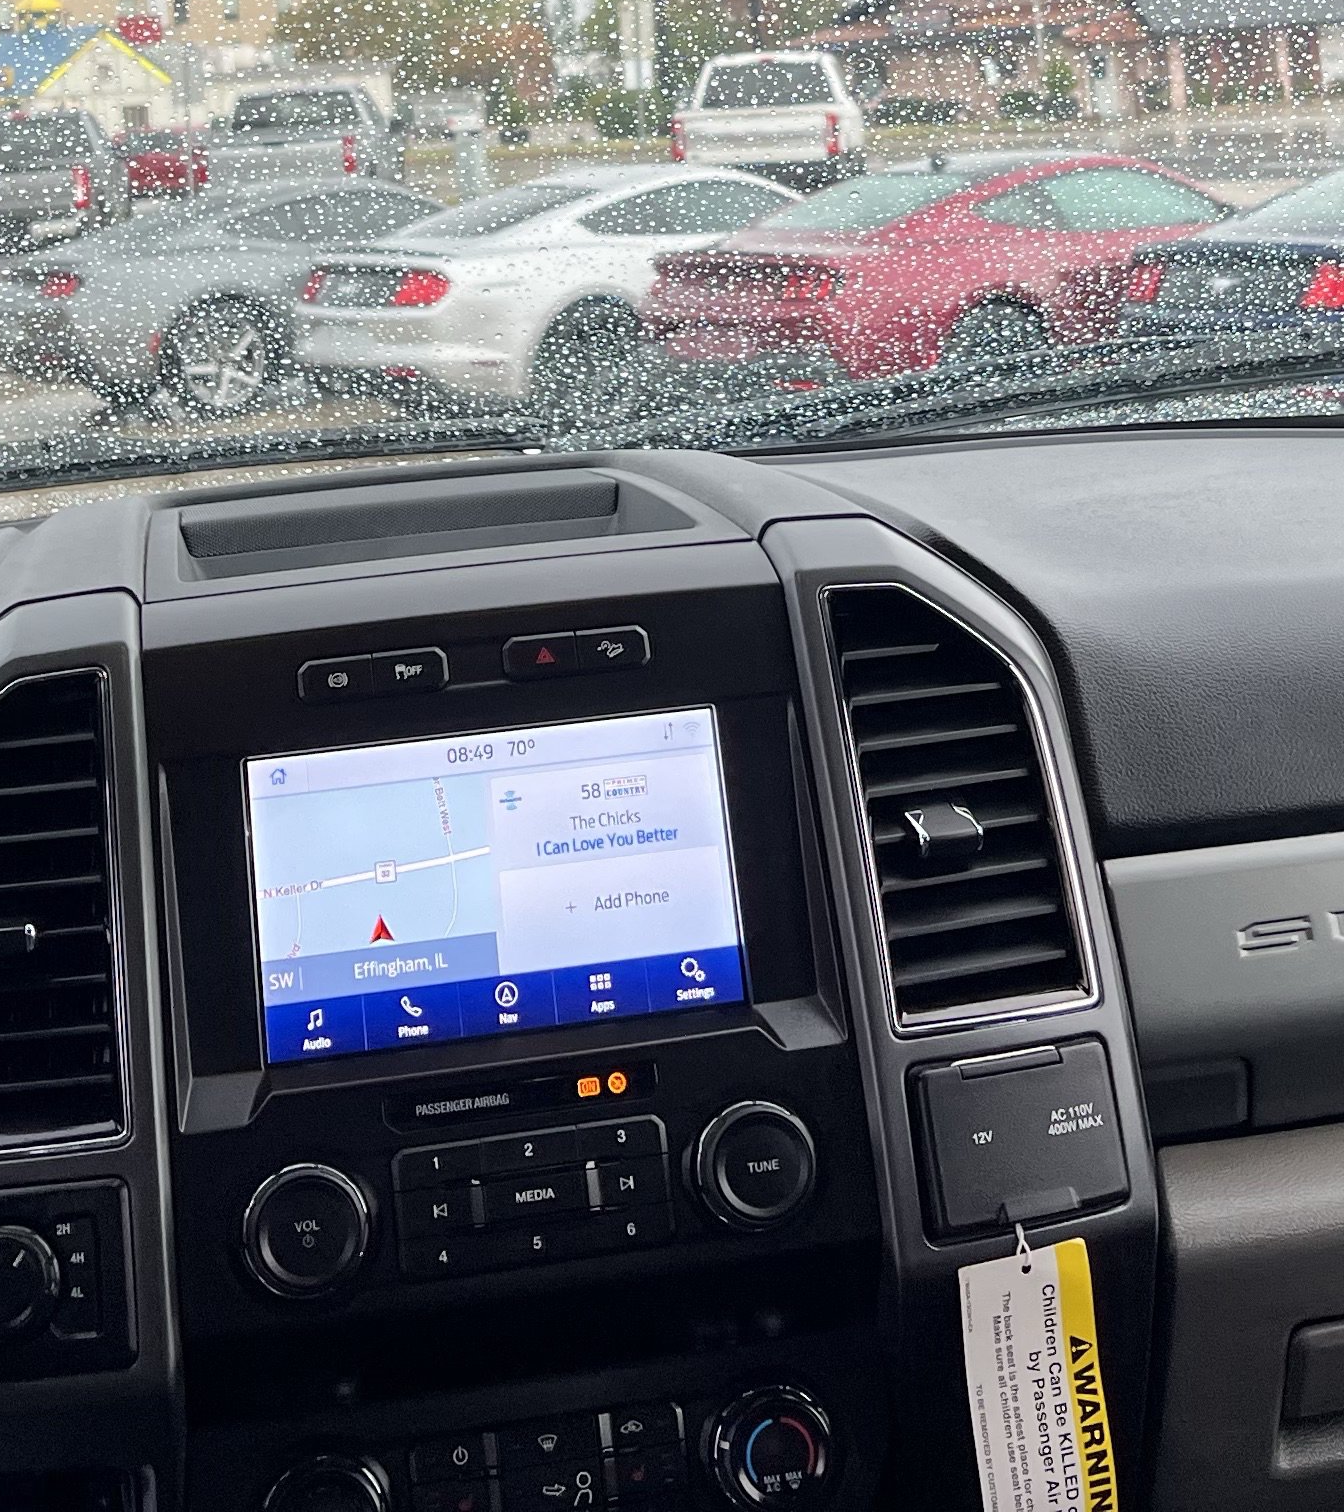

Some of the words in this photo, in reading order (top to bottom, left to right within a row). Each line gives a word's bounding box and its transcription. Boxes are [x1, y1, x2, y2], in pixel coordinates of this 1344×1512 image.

[405, 664, 423, 677] OFF
[446, 743, 494, 764] 08:49
[581, 784, 602, 800] 58
[606, 786, 646, 797] COUNTRY
[439, 808, 453, 836] West
[570, 816, 596, 831] The
[598, 810, 642, 828] Chicks
[543, 840, 570, 856] Can
[573, 837, 604, 852] Love
[606, 833, 634, 849] You
[636, 827, 679, 844] Better
[263, 889, 273, 898] N
[275, 884, 308, 897] Keller
[310, 880, 324, 891] Dr
[594, 893, 619, 911] Add
[623, 888, 670, 909] Phone
[354, 958, 432, 980] Effingham,
[435, 952, 449, 968] IL
[269, 972, 294, 989] SW
[676, 986, 715, 1003] Settings
[590, 999, 615, 1013] Apps
[498, 1012, 519, 1024] Nav
[398, 1023, 429, 1038] Phone
[302, 1037, 332, 1051] Audio
[415, 1098, 472, 1117] PASSENGER
[473, 1093, 510, 1109] AIRBAG
[1050, 1108, 1067, 1122] AC
[1068, 1102, 1094, 1118] 110V
[1048, 1120, 1077, 1136] 400W
[1078, 1114, 1104, 1130] MAX
[617, 1129, 627, 1143] 3
[972, 1130, 993, 1145] 12V
[524, 1143, 534, 1157] 2
[432, 1156, 439, 1170] 1
[746, 1158, 781, 1174] TUNE
[515, 1187, 555, 1204] MEDIA
[56, 1223, 71, 1236] 2H
[294, 1219, 320, 1233] VOL
[627, 1222, 636, 1236] 6
[533, 1236, 542, 1249] 5
[70, 1252, 85, 1264] 4H
[438, 1250, 448, 1263] 4
[70, 1286, 84, 1298] 4L
[1002, 1290, 1011, 1313] The
[992, 1315, 1002, 1345] Make
[1003, 1315, 1015, 1342] back
[1042, 1284, 1058, 1357] Children
[994, 1347, 1004, 1372] sure
[1006, 1345, 1016, 1369] seat
[1027, 1350, 1042, 1372] by
[998, 1374, 1007, 1389] all
[1008, 1371, 1017, 1382] is
[1049, 1362, 1062, 1397] Can
[976, 1384, 983, 1397] TO
[1009, 1383, 1019, 1403] the
[977, 1398, 985, 1410] BE
[999, 1391, 1013, 1439] children
[1013, 1406, 1026, 1441] safest
[1054, 1402, 1068, 1427] Be
[979, 1412, 991, 1457] REMOVED
[1031, 1378, 1055, 1474] Passenger
[1073, 1361, 1113, 1512] WARNIN
[1007, 1442, 1017, 1464] use
[1017, 1443, 1029, 1476] place
[985, 1459, 994, 1470] BY
[1058, 1432, 1080, 1501] KILLED
[785, 1470, 803, 1481] MAX
[1010, 1466, 1021, 1492] seat
[1023, 1478, 1033, 1495] for
[1046, 1480, 1061, 1504] Air
[1014, 1492, 1025, 1512] bel
